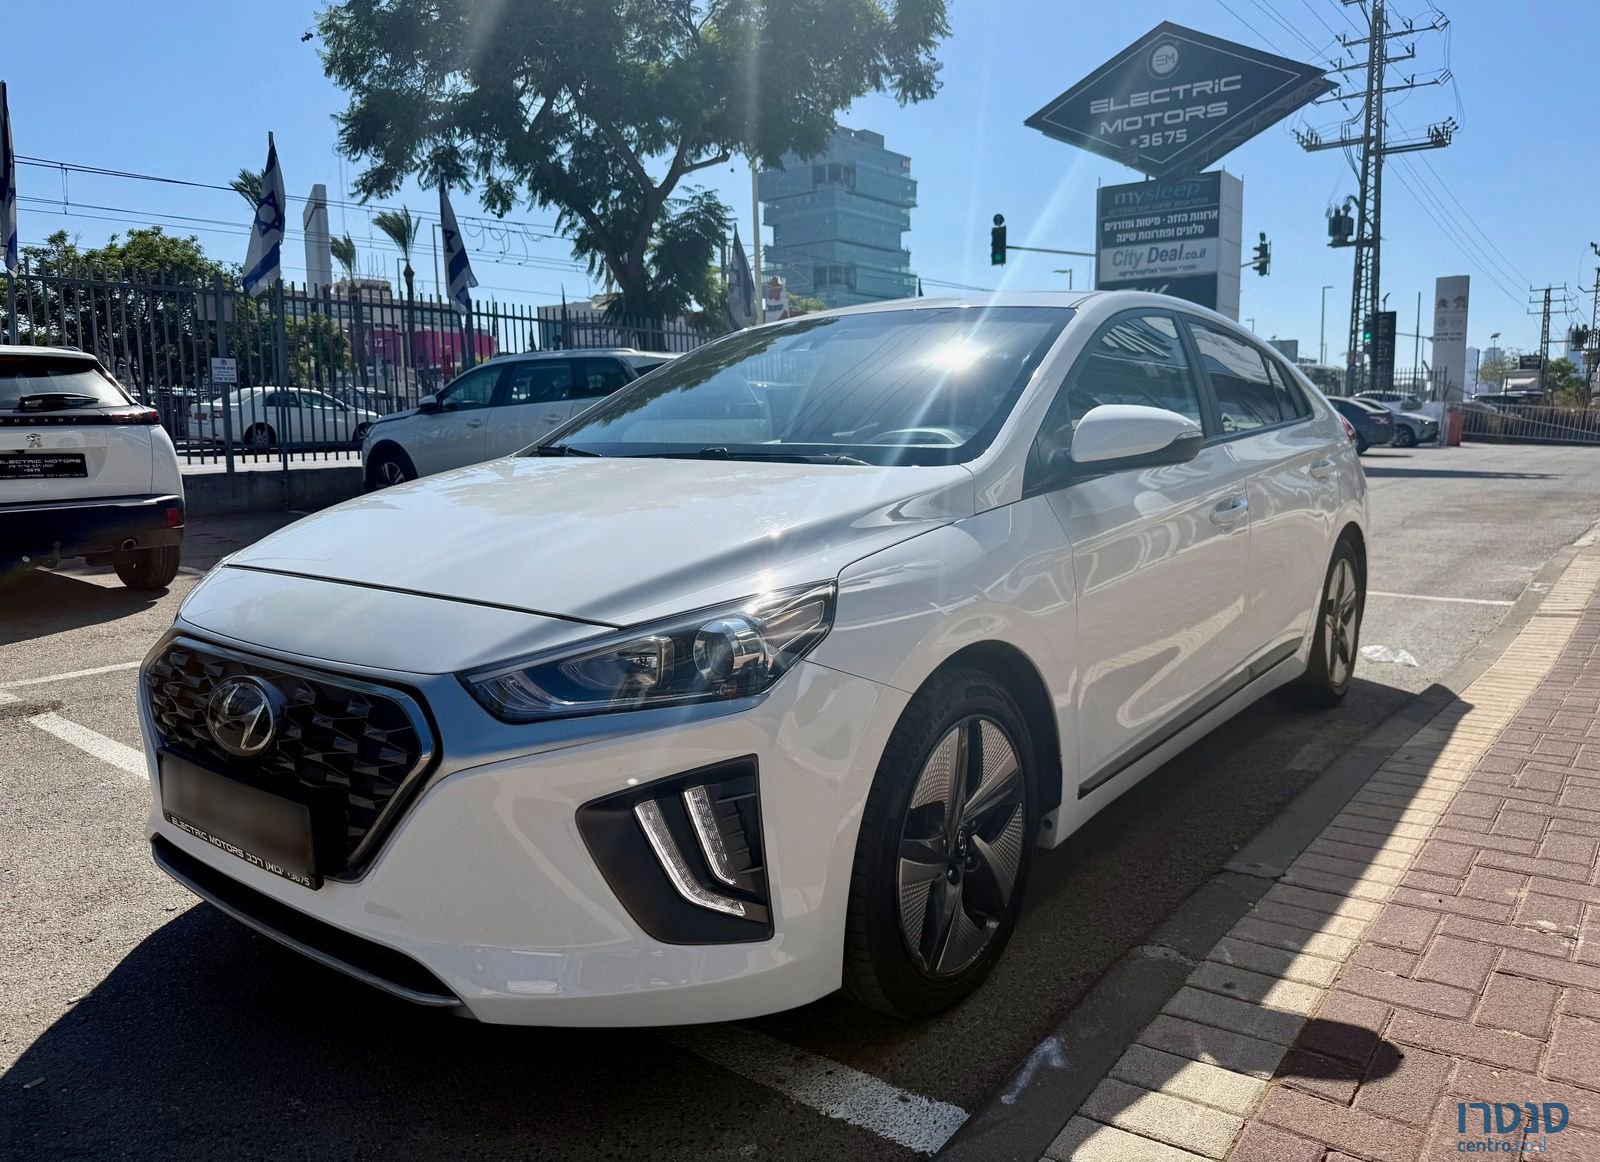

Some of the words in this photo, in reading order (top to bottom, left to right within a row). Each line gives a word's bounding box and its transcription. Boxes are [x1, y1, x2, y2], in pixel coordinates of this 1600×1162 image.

[1100, 101, 1229, 135] MOTORS
[1114, 183, 1201, 206] mysleep
[1136, 216, 1161, 228] מיטות
[1167, 212, 1188, 224] הזזה
[1189, 209, 1218, 222] ארונות
[1138, 227, 1175, 241] ופתרונות
[1176, 223, 1205, 237] סלונים
[1116, 232, 1137, 244] שינה
[1112, 248, 1143, 269] City
[208, 835, 245, 858] MOTORS
